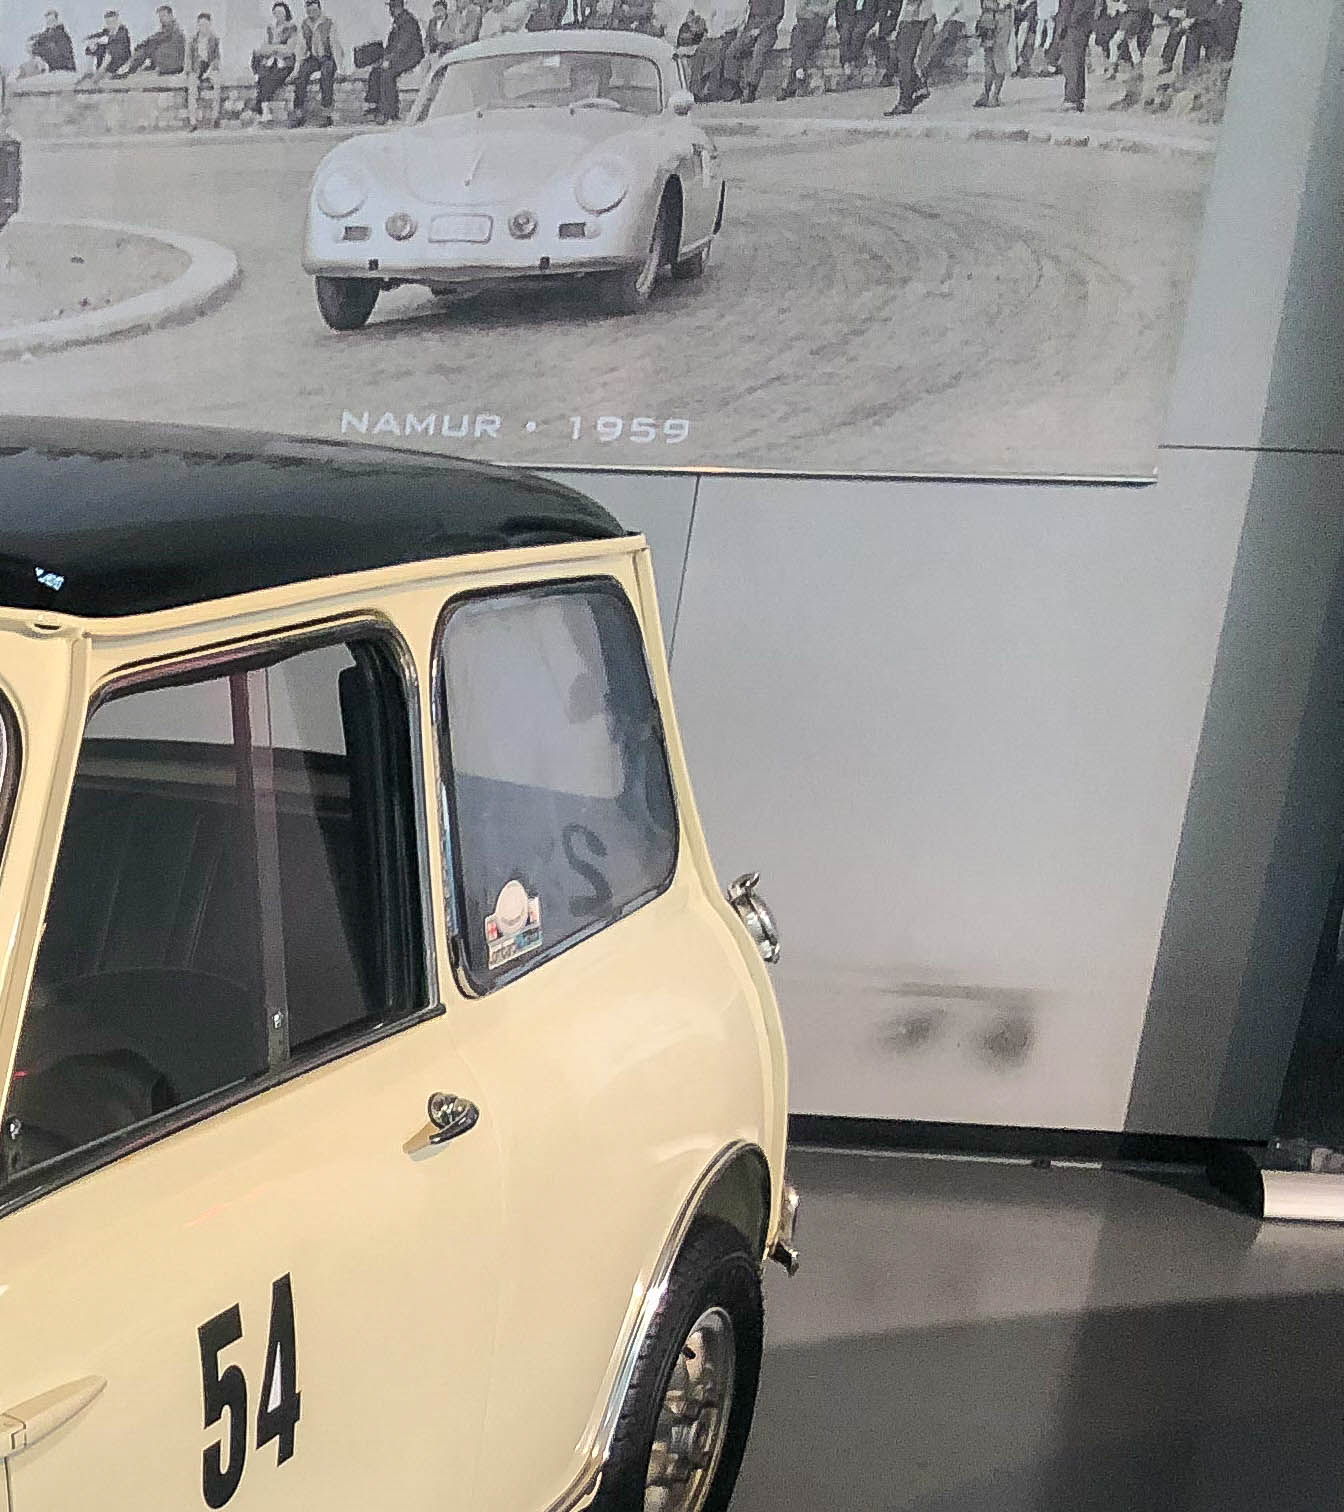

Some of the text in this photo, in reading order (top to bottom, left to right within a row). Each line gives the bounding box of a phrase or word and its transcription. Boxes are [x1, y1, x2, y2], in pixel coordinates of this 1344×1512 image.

[340, 408, 503, 439] NAMUR
[567, 415, 690, 444] 1959
[197, 1271, 302, 1510] 54
